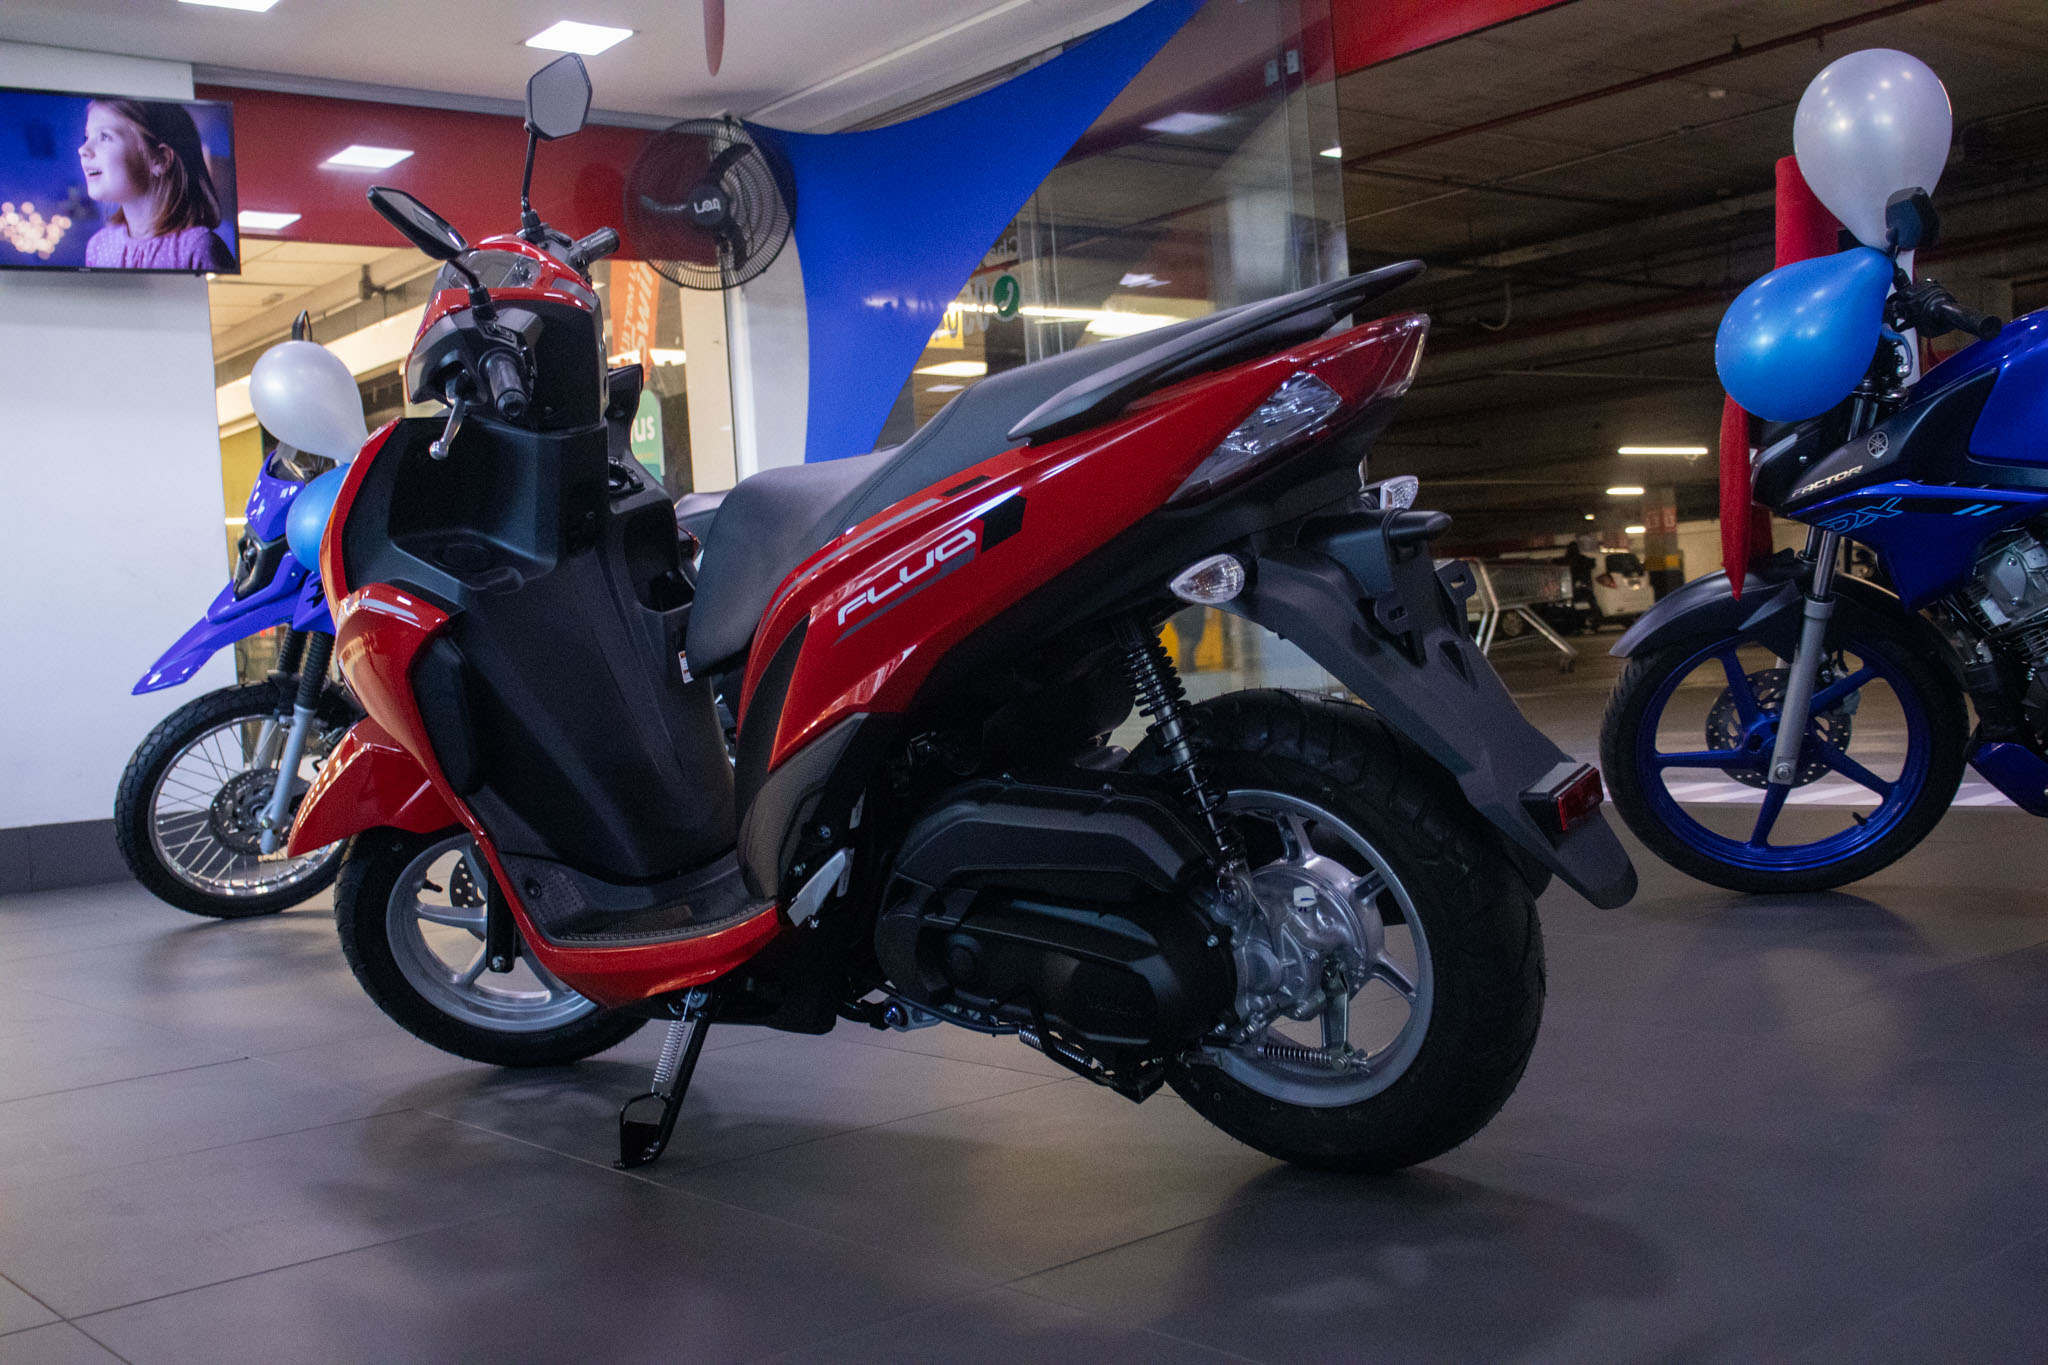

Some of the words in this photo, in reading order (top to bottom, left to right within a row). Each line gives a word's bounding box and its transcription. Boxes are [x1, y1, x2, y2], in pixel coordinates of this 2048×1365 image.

[631, 416, 656, 443] us
[1791, 465, 1863, 497] FACTOR
[1816, 497, 1904, 534] DX
[838, 529, 976, 626] FLUO
